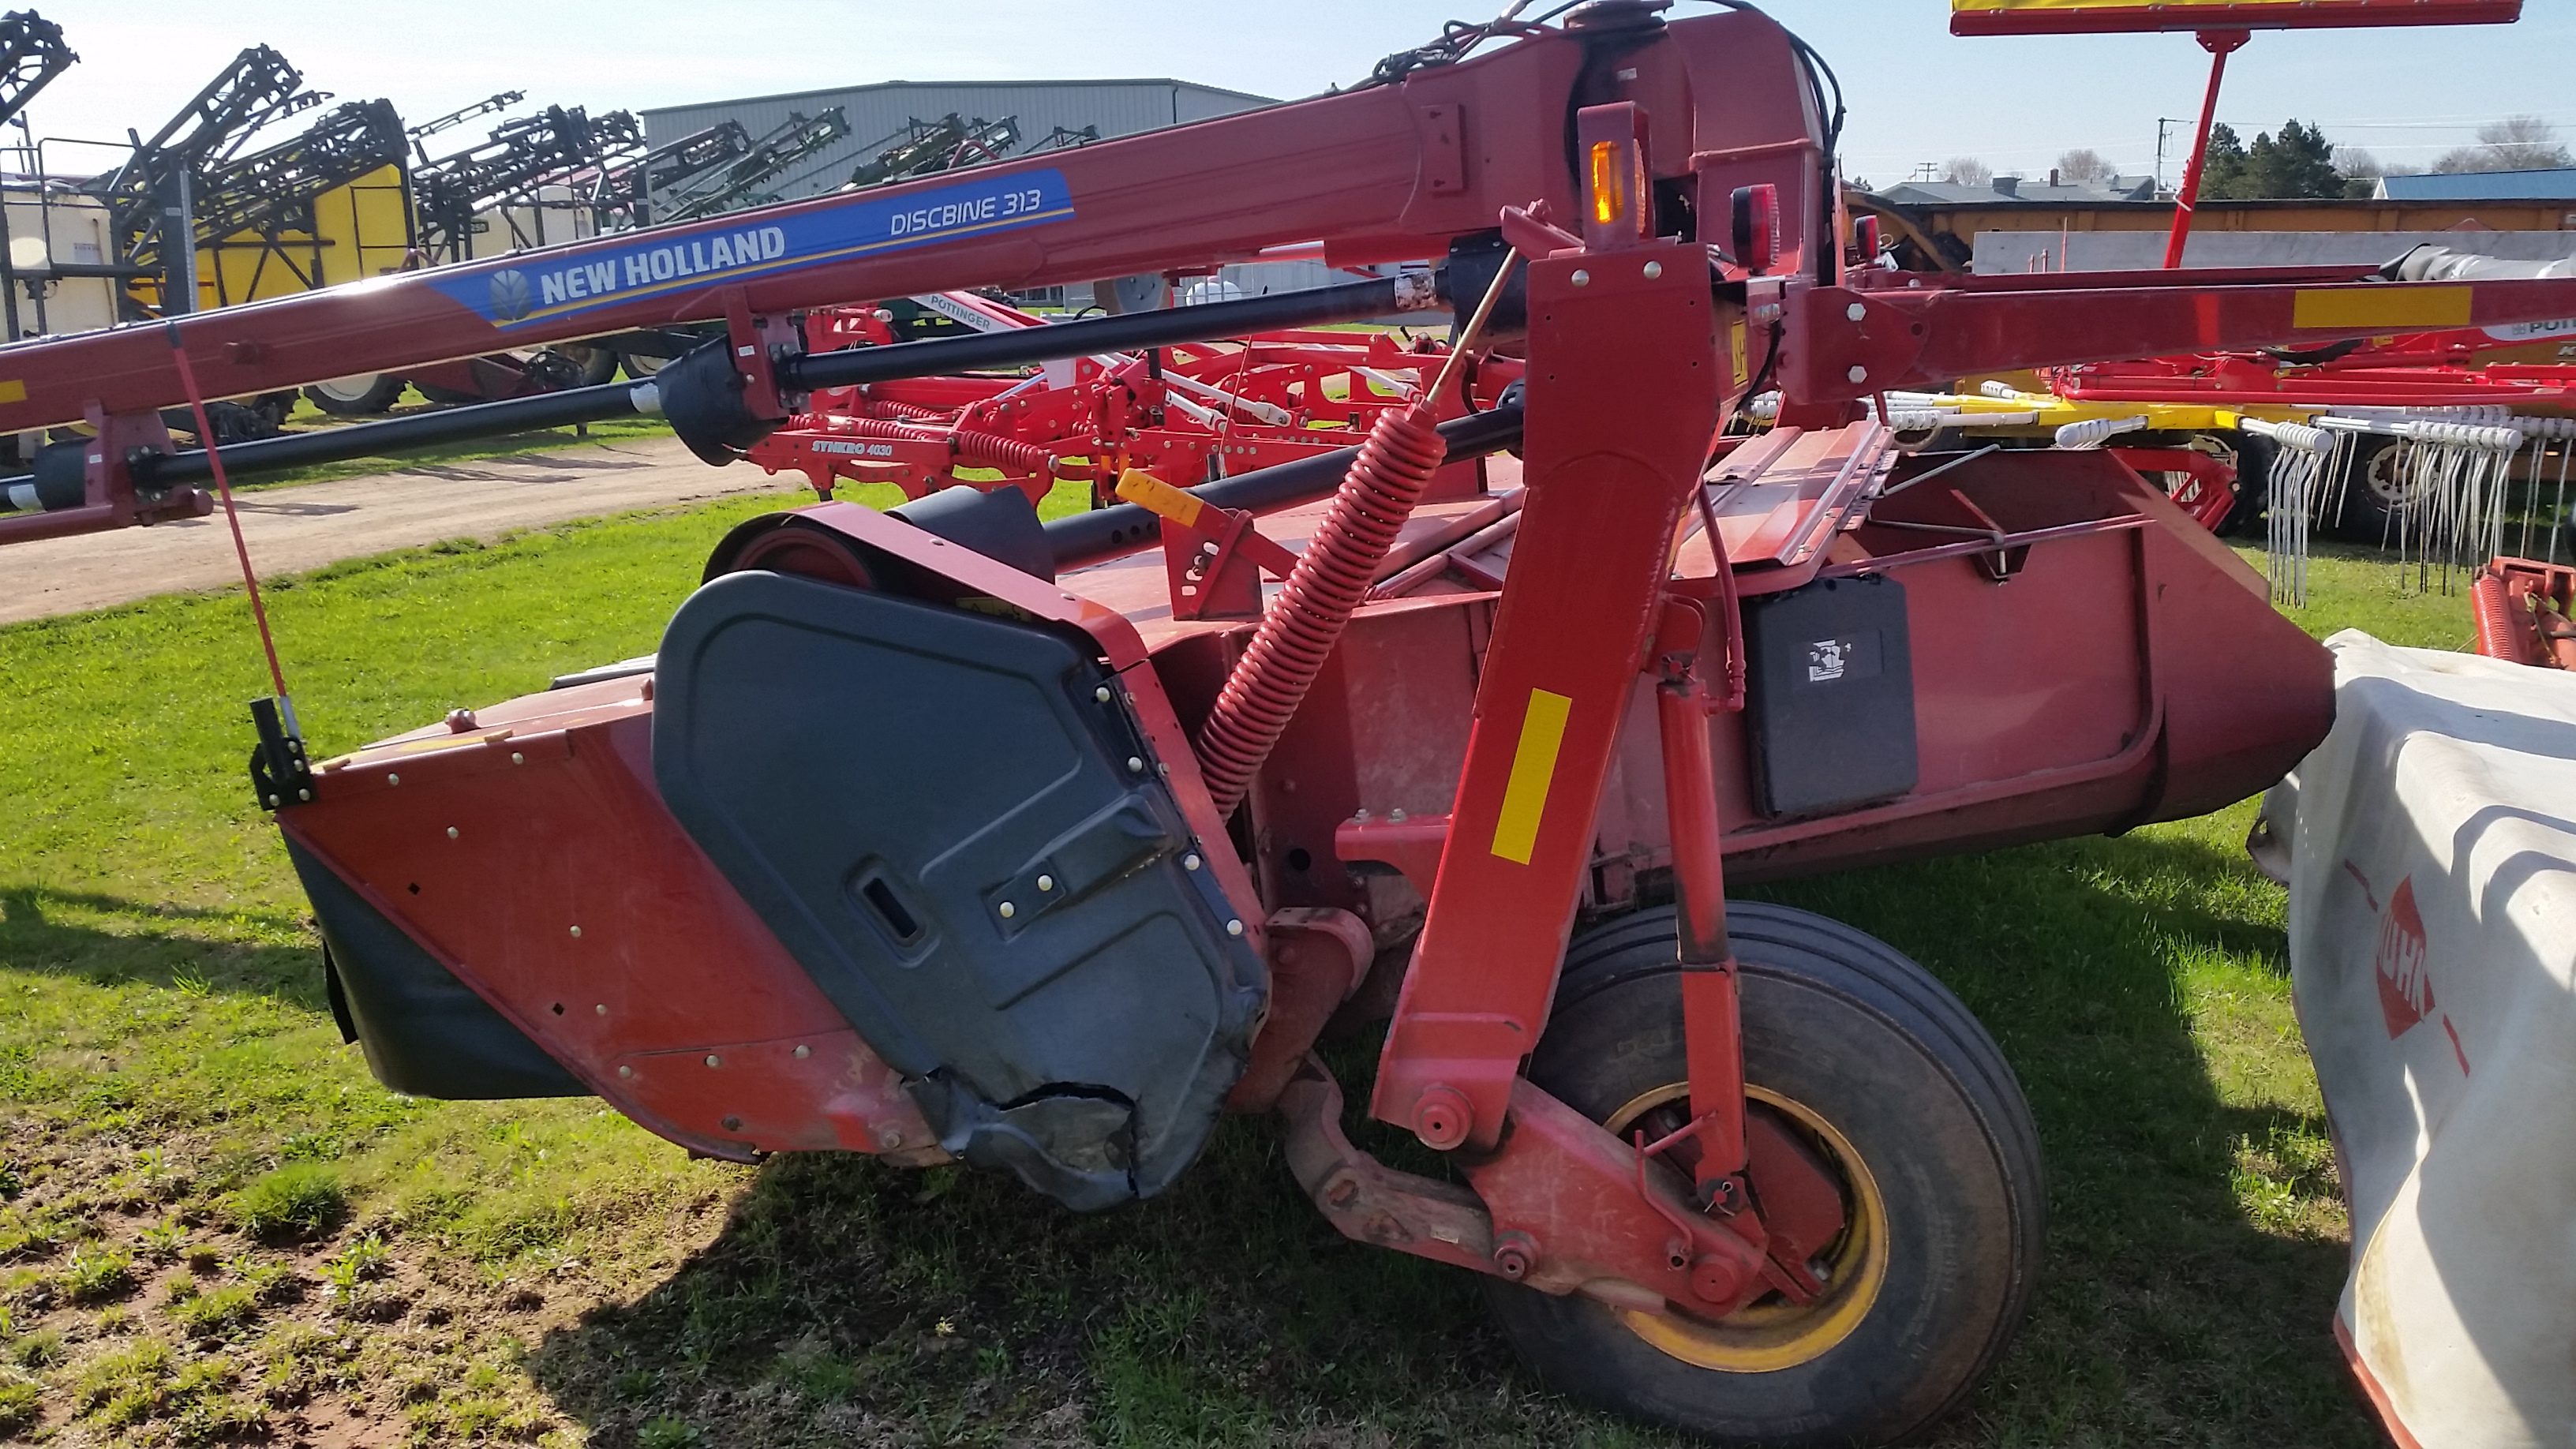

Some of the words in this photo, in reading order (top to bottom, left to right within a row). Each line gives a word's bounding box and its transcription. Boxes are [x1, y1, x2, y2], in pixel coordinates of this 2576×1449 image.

[891, 197, 996, 236] DISCBINE
[1002, 189, 1041, 215] 313
[541, 260, 616, 305] NEW
[624, 226, 785, 286] HOLLAND
[811, 440, 865, 455] SYNKRO
[867, 444, 893, 456] 4030
